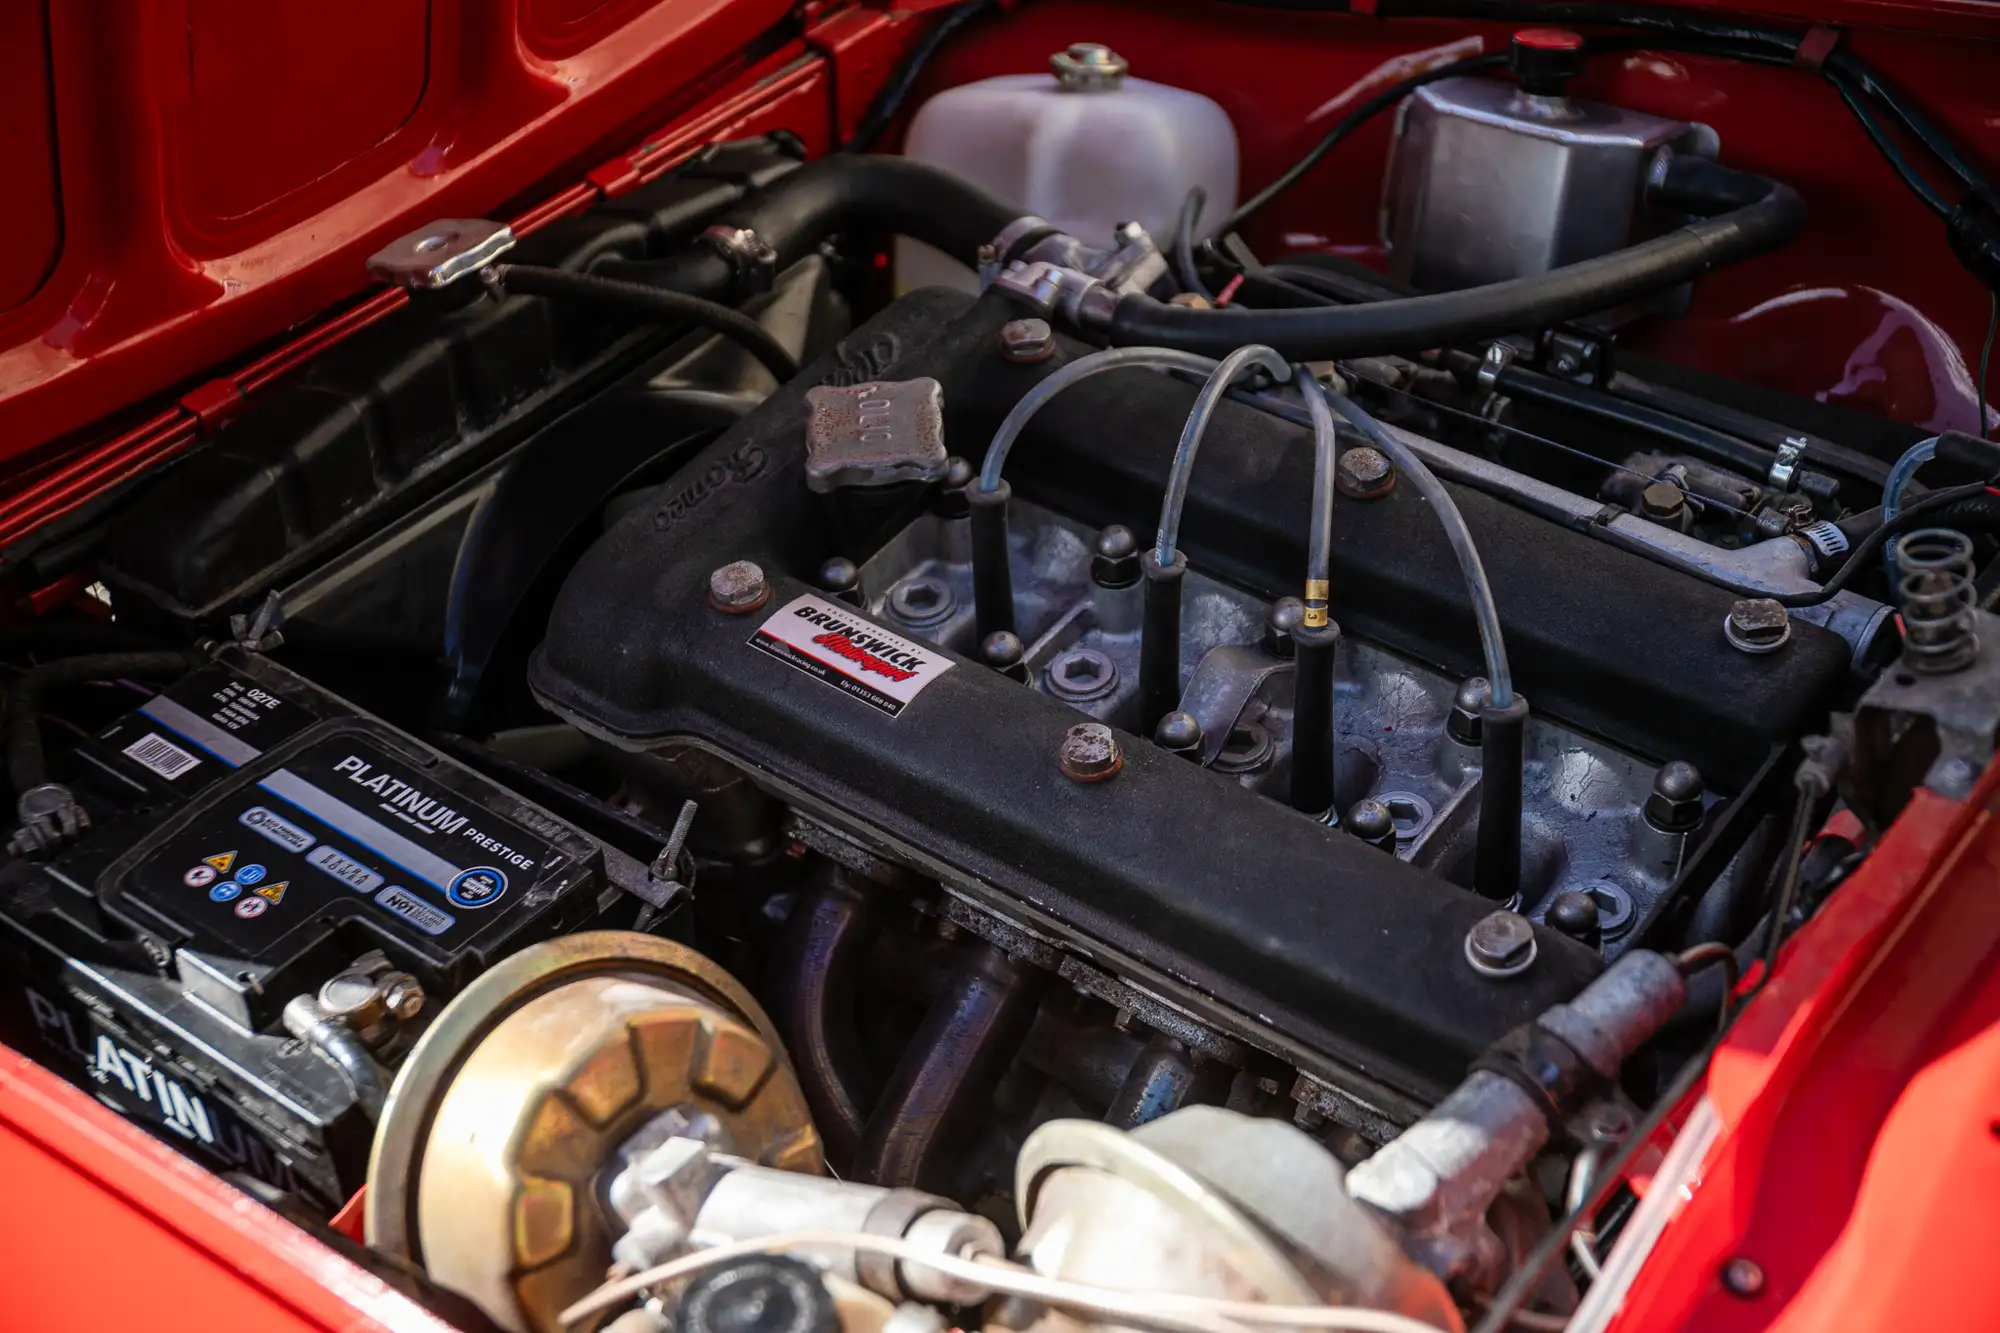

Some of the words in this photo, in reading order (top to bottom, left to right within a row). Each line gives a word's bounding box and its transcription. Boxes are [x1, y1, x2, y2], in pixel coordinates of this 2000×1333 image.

[793, 605, 927, 671] BRUNSWICK
[827, 607, 860, 626] RACING
[866, 627, 905, 647] ENGINES
[755, 638, 826, 676] www.brunswickracing.co.uk
[813, 632, 920, 682] Motorsport
[247, 688, 282, 710] 027E
[333, 755, 470, 834] PLATINUM
[463, 827, 535, 870] PRESTIGE
[320, 858, 366, 885] POWER
[327, 853, 370, 880] EXTRA
